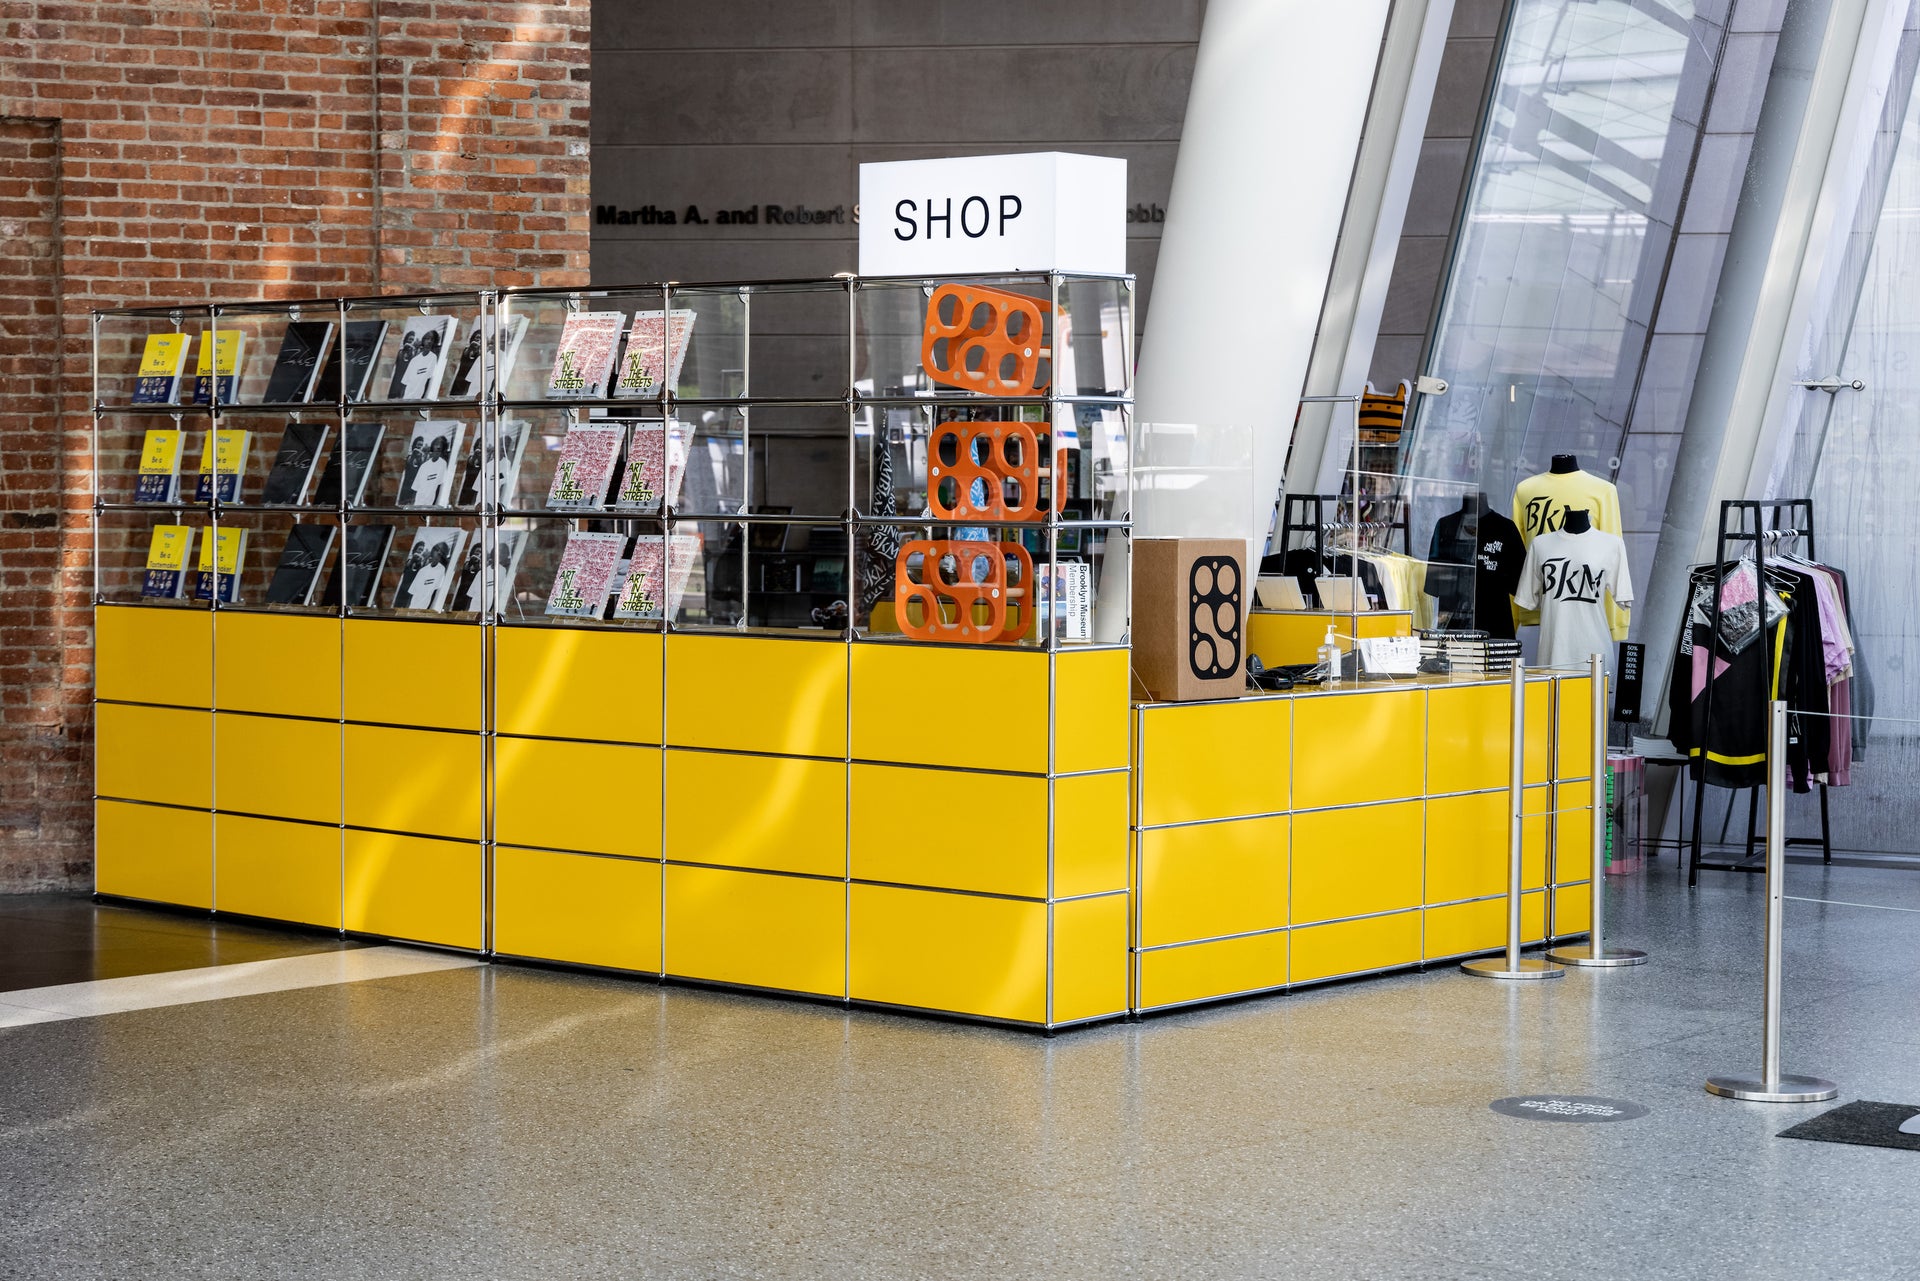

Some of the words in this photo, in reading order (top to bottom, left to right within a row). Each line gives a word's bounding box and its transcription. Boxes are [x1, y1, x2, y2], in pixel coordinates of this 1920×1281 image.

[596, 205, 676, 225] Martha
[684, 205, 708, 225] A.
[716, 205, 758, 225] and
[766, 204, 845, 225] Robert
[894, 195, 1022, 241] SHOP
[559, 351, 575, 361] ART
[563, 361, 572, 370] IN
[631, 361, 640, 370] IN
[561, 370, 574, 380] THE
[629, 369, 642, 379] THE
[553, 379, 584, 389] STREETS
[621, 378, 652, 389] STREETS
[559, 462, 575, 472] ART
[627, 463, 644, 472] ART
[563, 472, 571, 481] IN
[631, 472, 640, 482] IN
[561, 481, 573, 490] THE
[629, 482, 643, 491] THE
[553, 490, 583, 501] STREETS
[622, 491, 653, 501] STREETS
[149, 561, 178, 569] Tastemaker
[559, 570, 576, 579] ART
[628, 573, 646, 583] ART
[562, 580, 571, 589] IN
[632, 583, 641, 592] IN
[1078, 565, 1088, 603] Brooklyn
[560, 589, 573, 599] THE
[1068, 564, 1077, 617] Membership
[630, 592, 643, 602] THE
[553, 598, 583, 609] STREETS
[621, 602, 654, 612] STREETS
[1080, 604, 1088, 640] Museum
